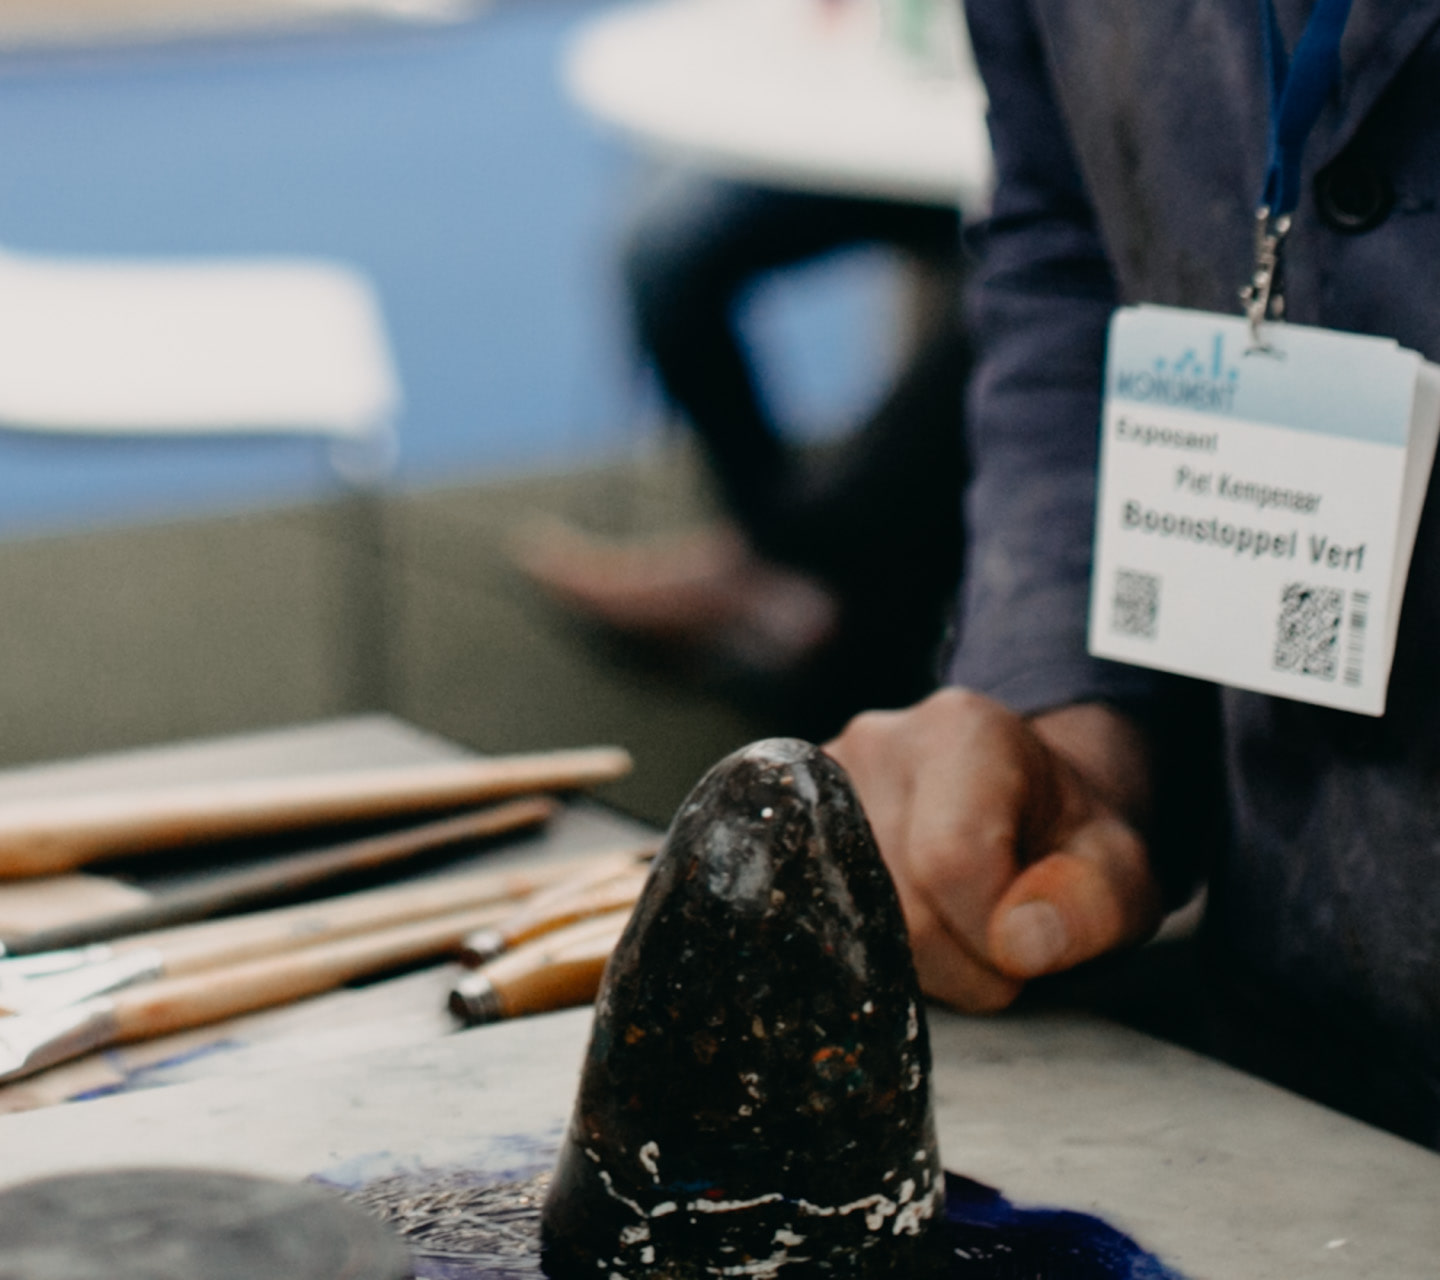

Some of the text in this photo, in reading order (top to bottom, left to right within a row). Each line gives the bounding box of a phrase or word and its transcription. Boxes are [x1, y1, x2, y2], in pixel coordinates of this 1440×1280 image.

[1117, 371, 1236, 413] MONUMENT
[1118, 418, 1218, 452] Exposant
[1218, 473, 1322, 513] Kempenaar
[1123, 500, 1366, 573] Boonstoppel Verf
